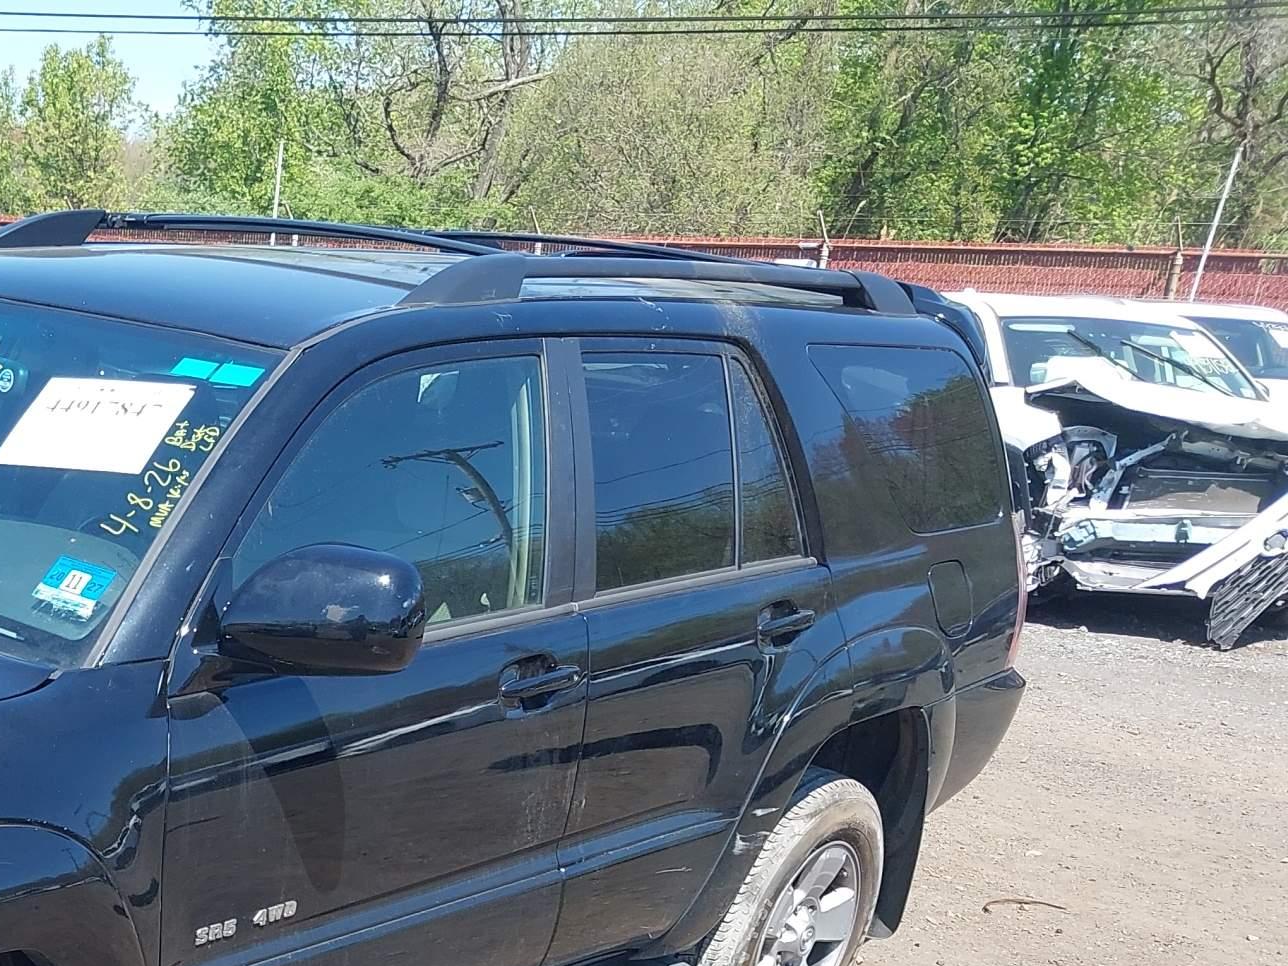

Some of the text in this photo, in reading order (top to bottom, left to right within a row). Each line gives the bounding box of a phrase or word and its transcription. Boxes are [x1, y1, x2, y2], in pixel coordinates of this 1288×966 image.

[100, 458, 181, 535] 4-8-26
[64, 573, 83, 590] 11
[87, 582, 105, 593] 27
[195, 900, 298, 946] SR5 4WD
